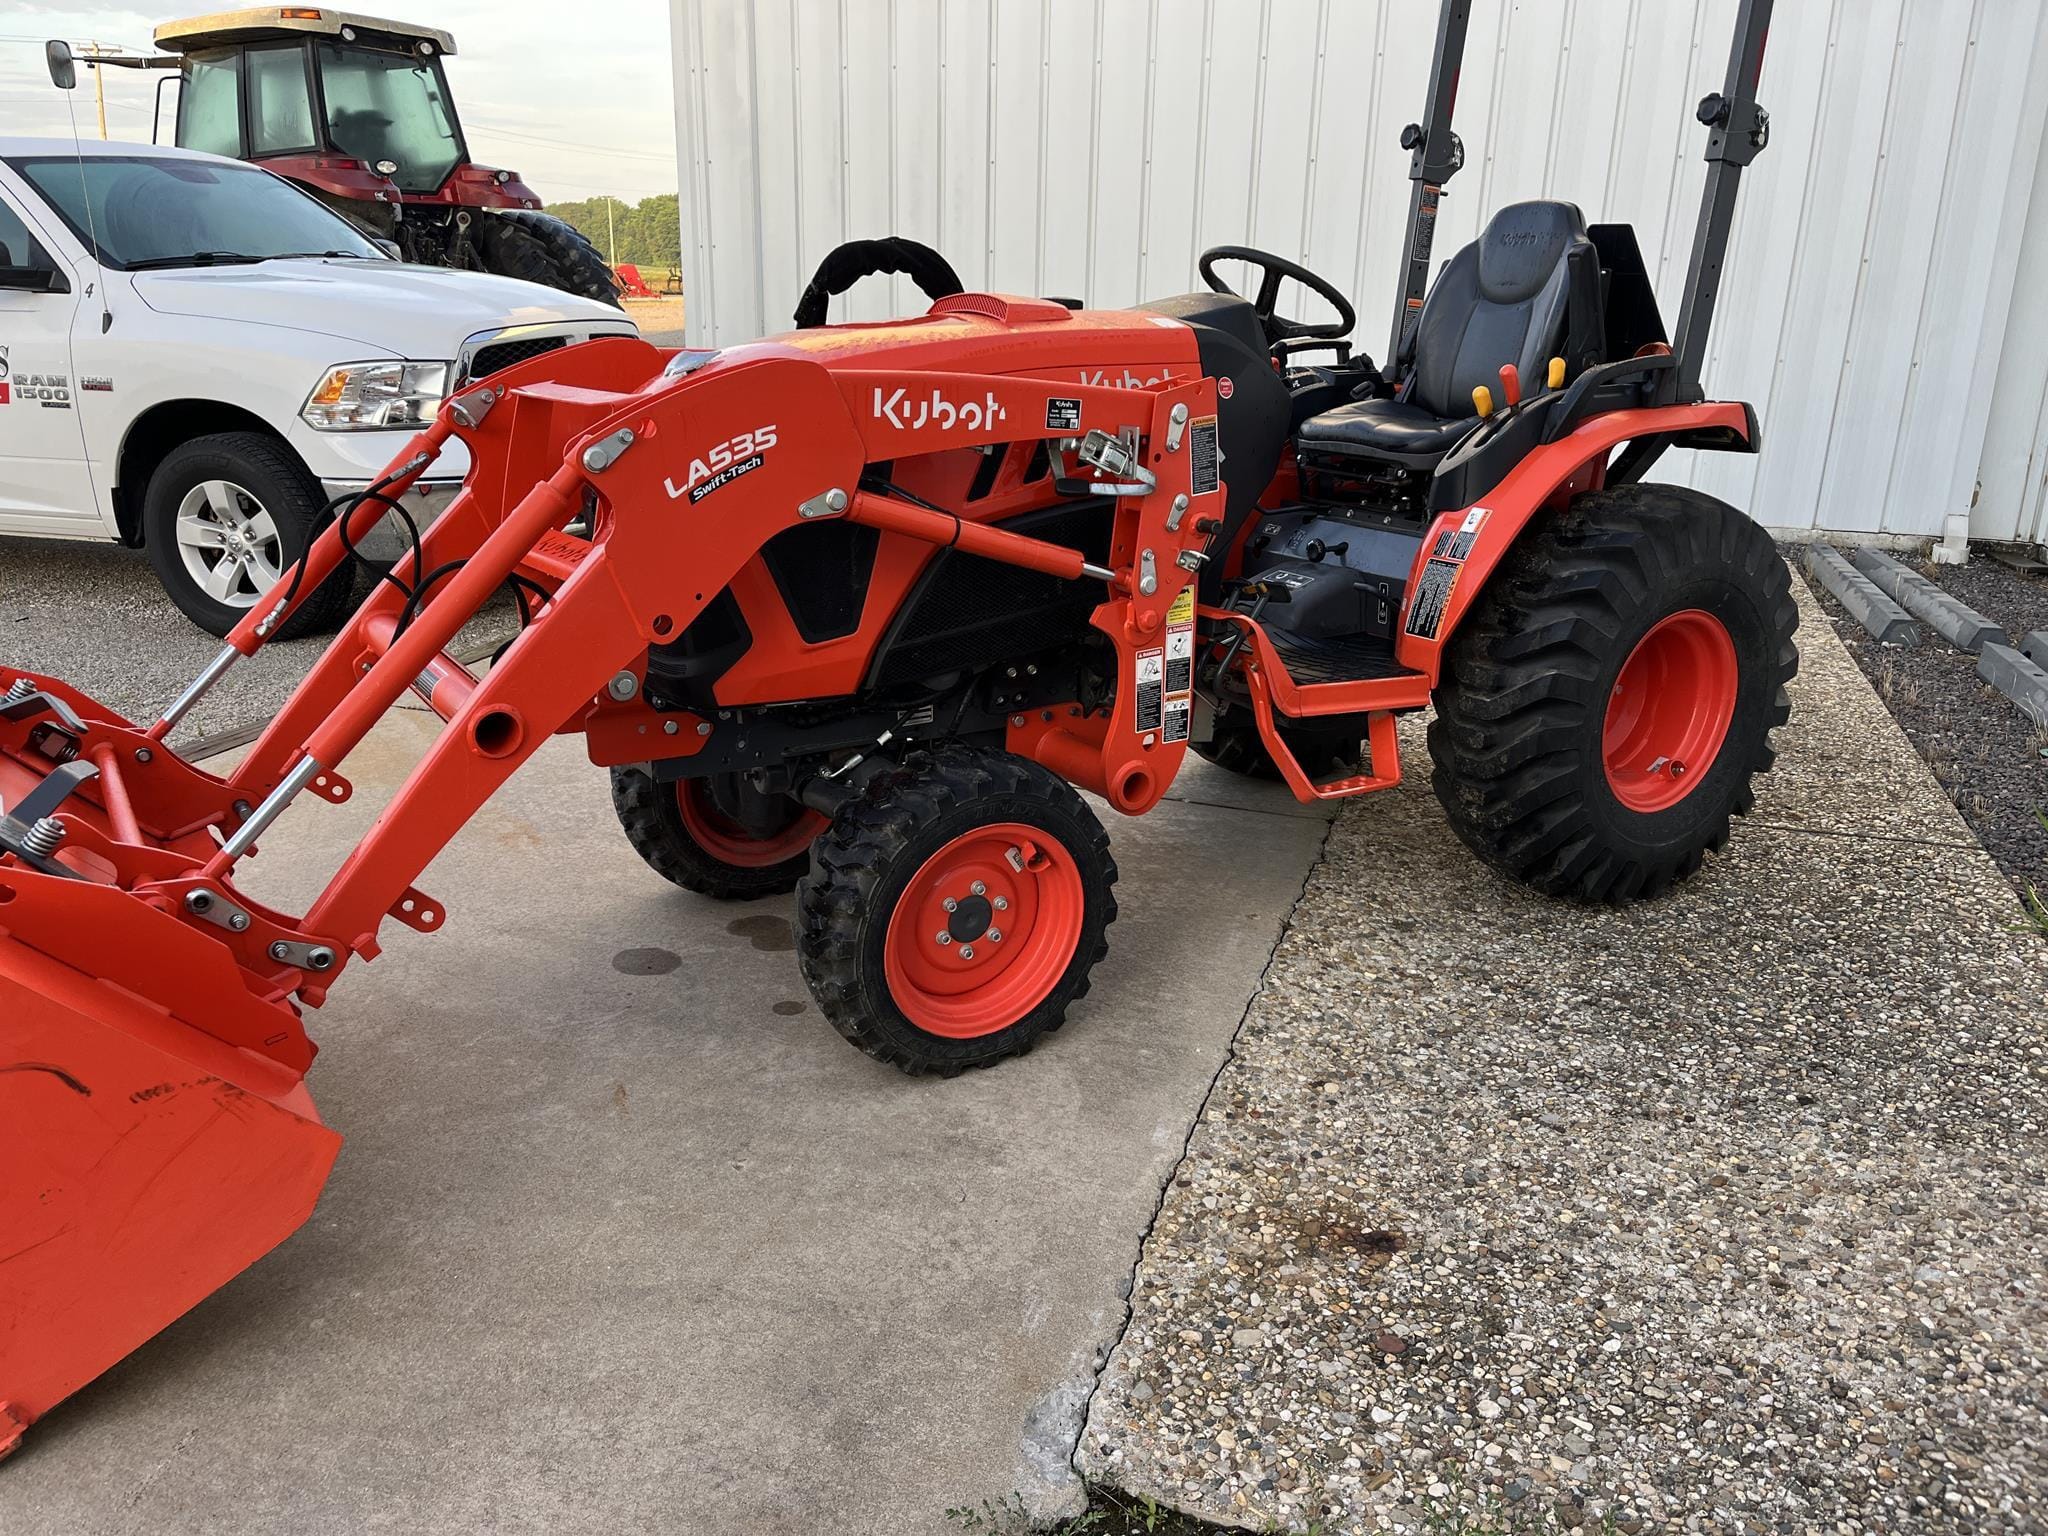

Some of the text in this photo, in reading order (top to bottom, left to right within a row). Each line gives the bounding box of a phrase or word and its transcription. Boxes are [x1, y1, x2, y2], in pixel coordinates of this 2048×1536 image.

[85, 282, 95, 299] 4
[12, 373, 67, 388] RAM
[14, 386, 70, 401] 1500
[873, 387, 1007, 431] Kubota
[663, 424, 778, 499] LA535
[692, 456, 762, 501] Swift-Tach
